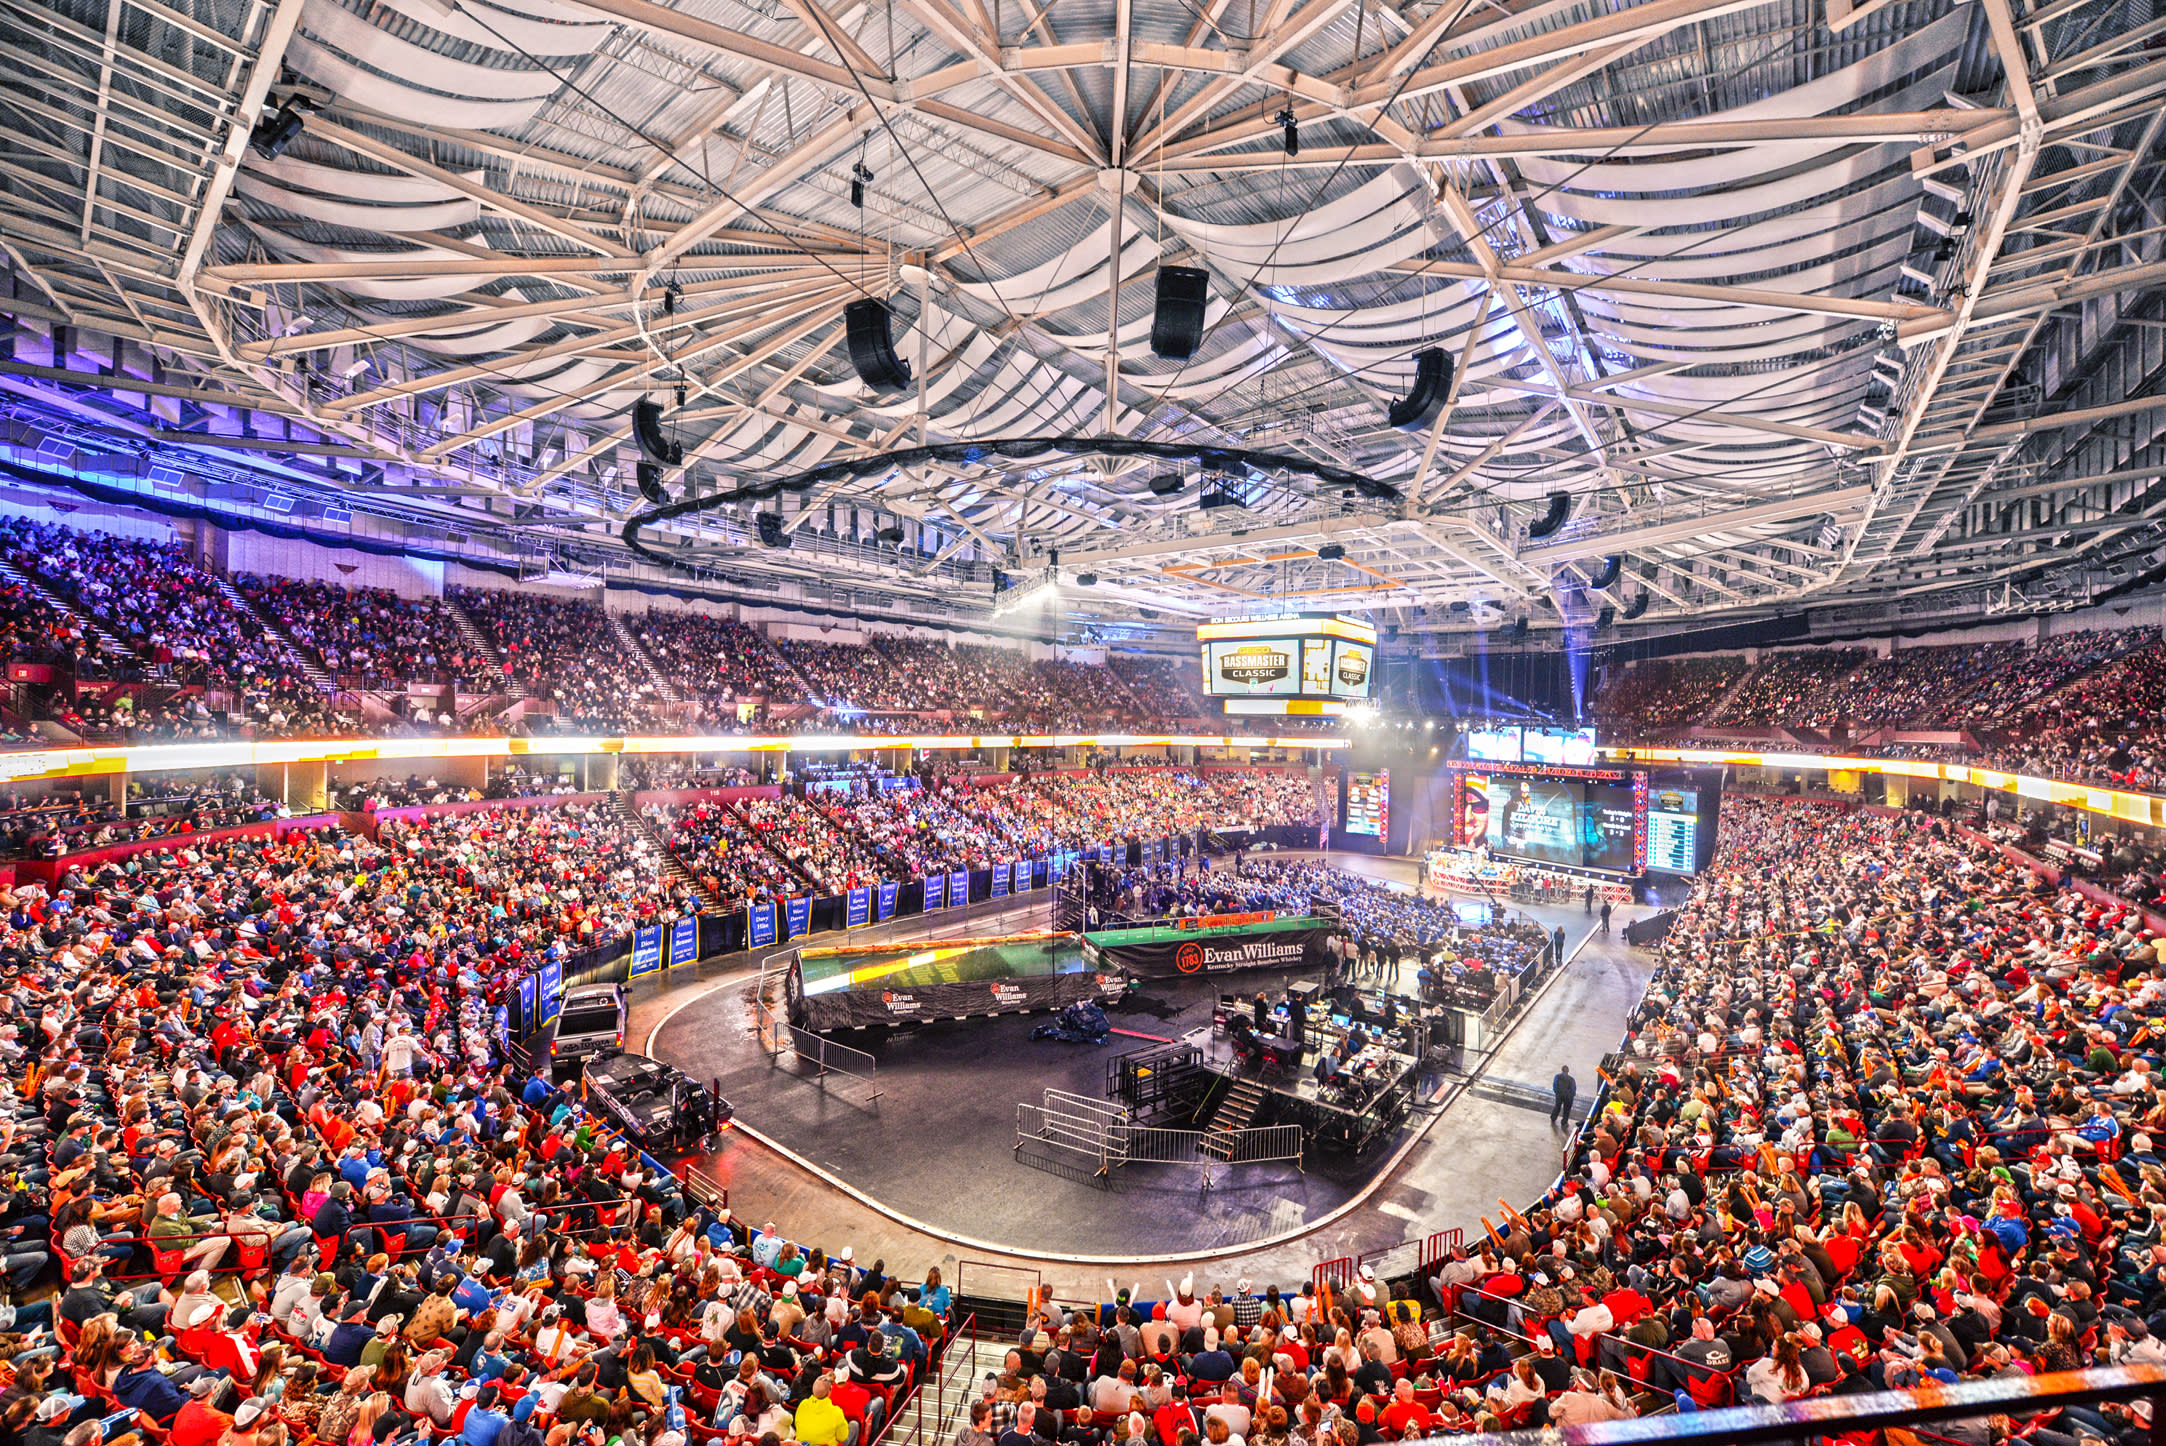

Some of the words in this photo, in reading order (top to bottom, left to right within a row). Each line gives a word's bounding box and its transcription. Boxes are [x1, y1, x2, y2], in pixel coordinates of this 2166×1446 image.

[1224, 655, 1285, 667] BASSMASTER
[1233, 669, 1276, 677] CLASSIC
[196, 835, 211, 845] 117
[755, 905, 770, 913] 1999
[641, 928, 655, 937] 1997
[1204, 948, 1243, 963] Evan
[1243, 943, 1303, 960] Williams
[1181, 954, 1199, 968] 1783
[1207, 962, 1234, 970] Kentucky
[1235, 960, 1257, 969] Straight
[1105, 975, 1122, 984] Evan
[892, 994, 913, 1002] Evan
[995, 992, 1027, 1001] Williams
[886, 1002, 921, 1011] Williams
[580, 1039, 610, 1049] TOYOTA
